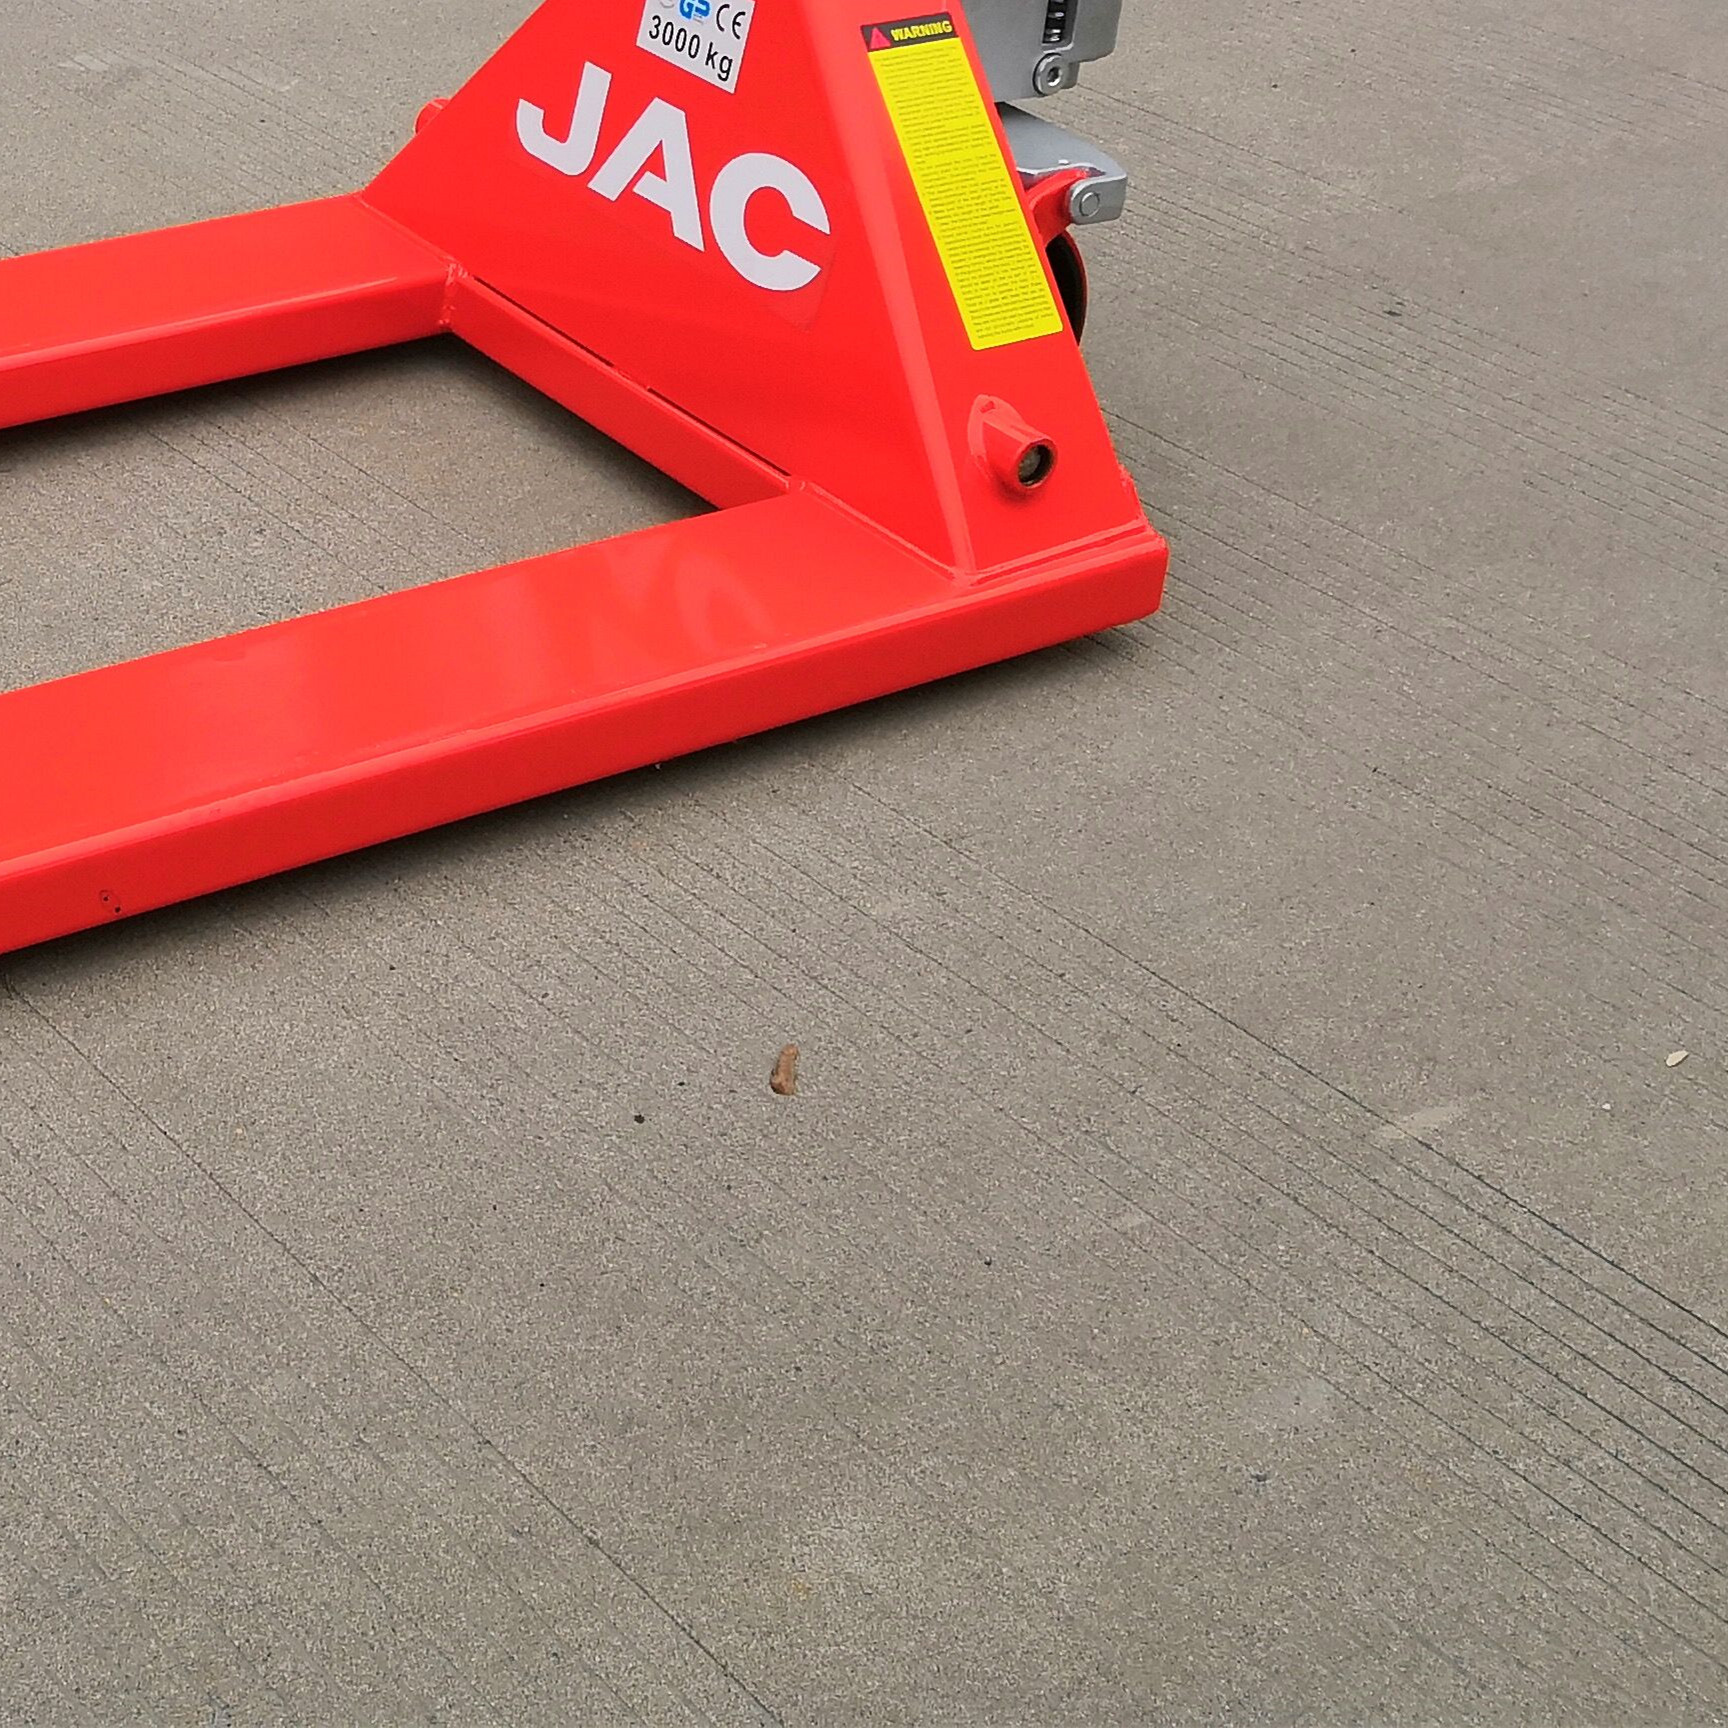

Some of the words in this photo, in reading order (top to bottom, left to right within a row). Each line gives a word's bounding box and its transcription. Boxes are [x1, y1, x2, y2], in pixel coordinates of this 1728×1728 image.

[648, 14, 701, 59] 3000
[704, 41, 733, 82] kg
[890, 20, 953, 41] WARNING
[515, 60, 831, 292] JAC
